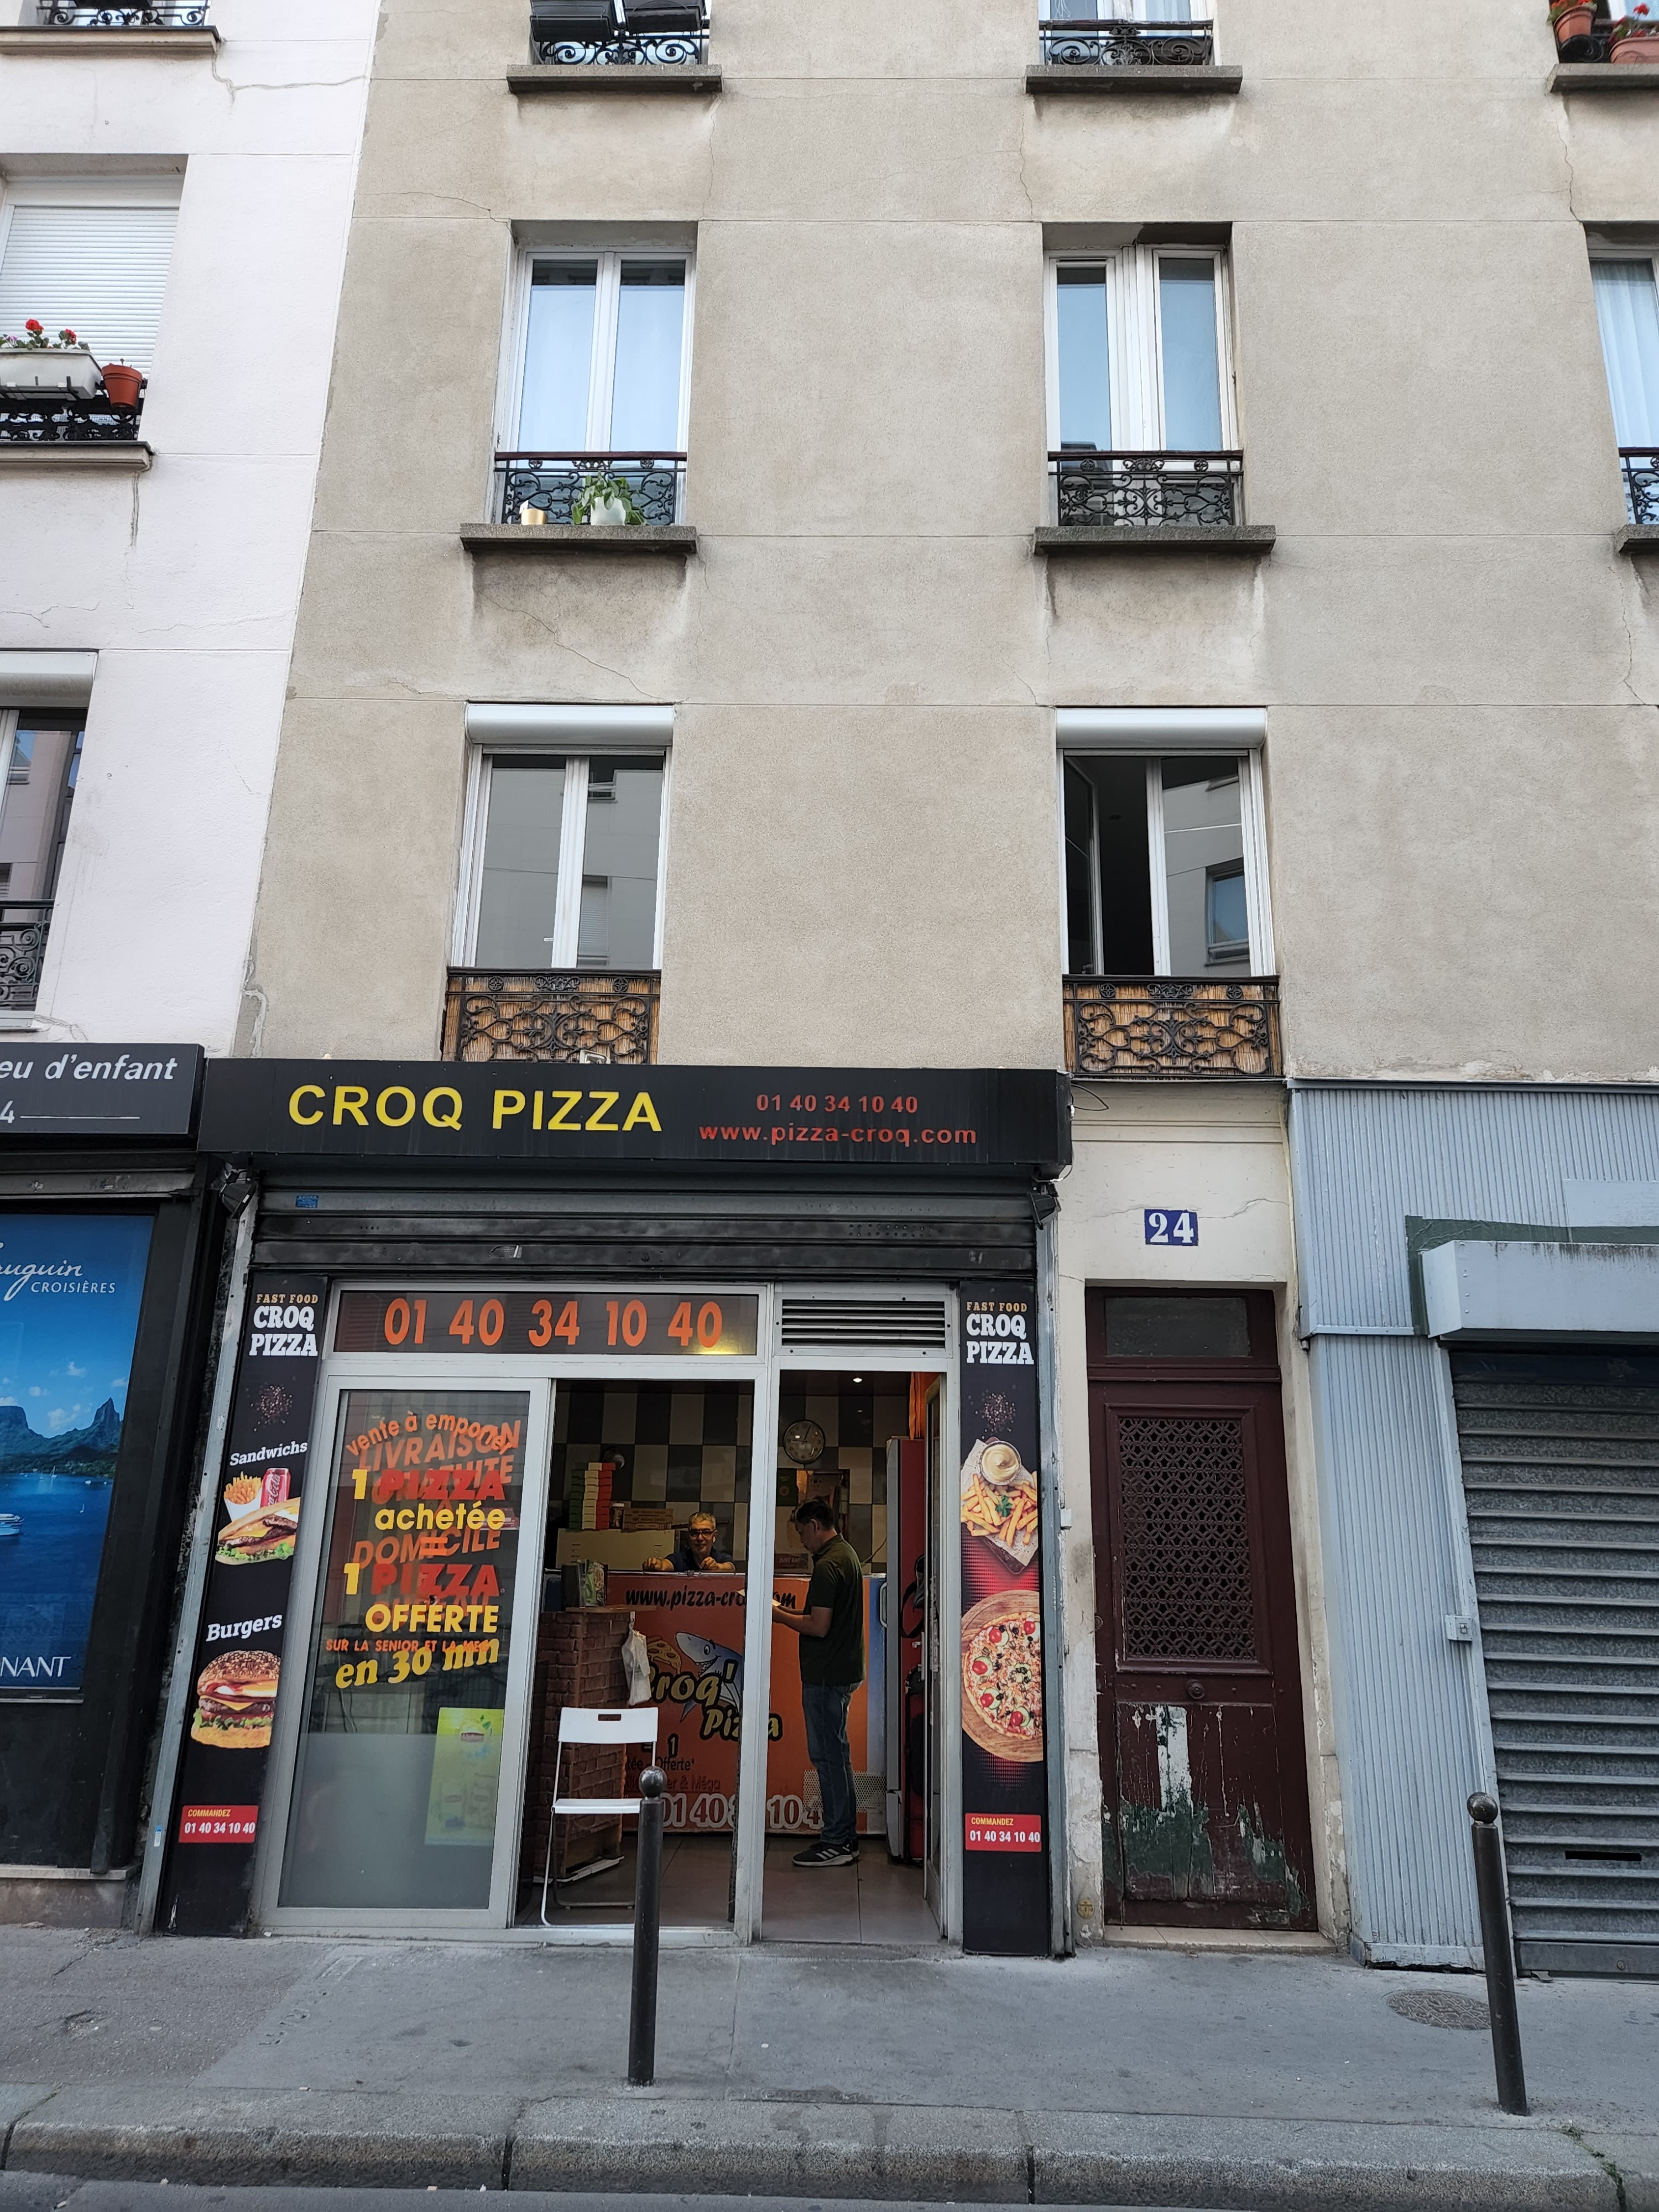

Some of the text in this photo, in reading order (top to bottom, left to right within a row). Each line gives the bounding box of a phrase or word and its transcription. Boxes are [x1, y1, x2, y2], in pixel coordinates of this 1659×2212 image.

[45, 1053, 178, 1080] d'enfant
[289, 1084, 662, 1131] CROQ PIZZA
[757, 1094, 919, 1114] 01 40 34 10 40
[699, 1123, 977, 1148] www.pizza-croq.com
[1149, 1212, 1194, 1244] 24
[31, 1279, 116, 1294] CROISIÈRES
[256, 1293, 319, 1305] FAST FOOD
[253, 1305, 315, 1332] CROQ
[966, 1301, 1027, 1312] FAST FOOD
[384, 1298, 723, 1349] 01 40 34 10 40
[966, 1313, 1027, 1339] CROQ
[249, 1333, 319, 1357] PIZZA
[966, 1340, 1034, 1365] PIZZA
[346, 1420, 400, 1456] vente
[405, 1411, 418, 1433] à
[229, 1440, 309, 1467] Sandwichs
[352, 1469, 506, 1500] 1 PIZZA
[374, 1500, 505, 1530] achetée
[343, 1562, 500, 1597] 1 PIZZA
[206, 1614, 283, 1642] Burgers
[365, 1604, 500, 1634] OFFERTE
[325, 1638, 348, 1652] SUR
[354, 1639, 369, 1652] LA
[375, 1639, 419, 1652] SENIOR
[424, 1640, 438, 1653] ET
[441, 1640, 457, 1653] LA
[0, 1656, 72, 1678] NANT
[335, 1637, 500, 1689] en 30 mn
[188, 1809, 231, 1818] COMMANDEZ
[971, 1817, 1014, 1826] COMMANDEZ
[184, 1822, 256, 1834] 01 40 34 10 40
[969, 1830, 1041, 1843] 01 40 34 10 40
